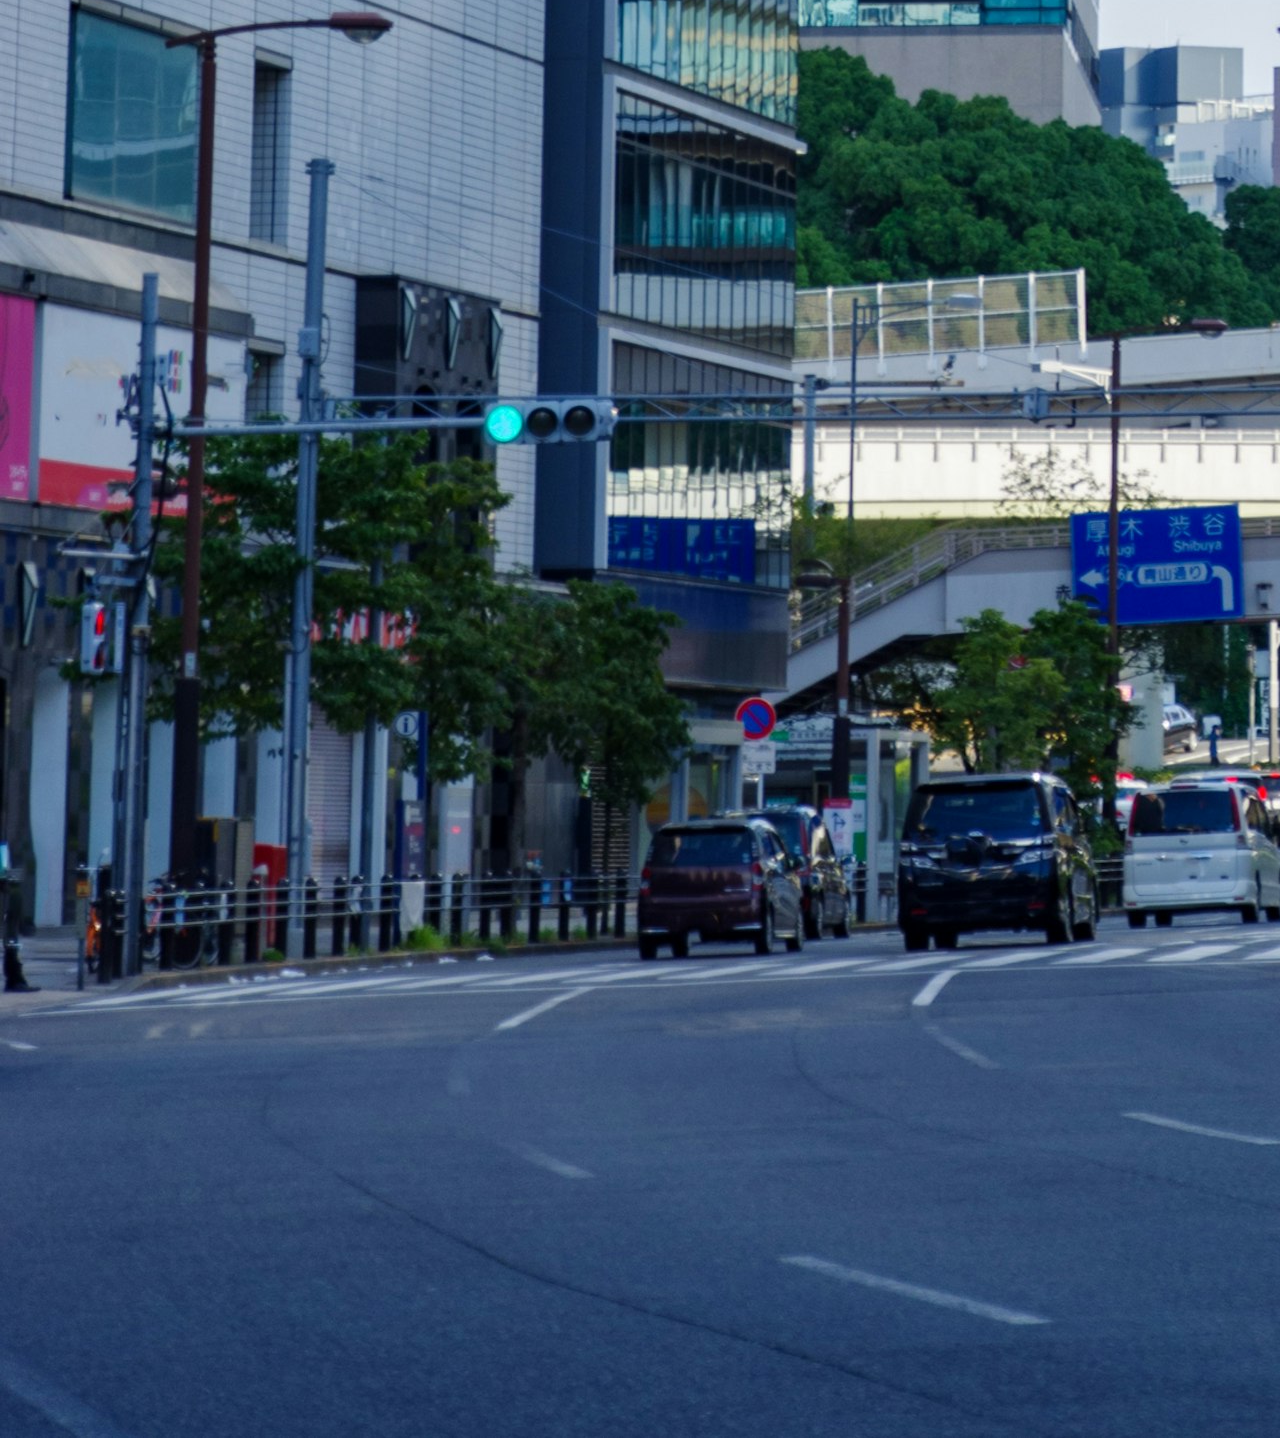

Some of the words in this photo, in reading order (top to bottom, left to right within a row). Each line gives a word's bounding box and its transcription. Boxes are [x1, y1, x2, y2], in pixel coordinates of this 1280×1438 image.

[1168, 513, 1225, 538] 渋谷
[1096, 544, 1136, 558] Atugi
[1173, 540, 1222, 554] Shibuya
[1144, 565, 1202, 582] 青山通り
